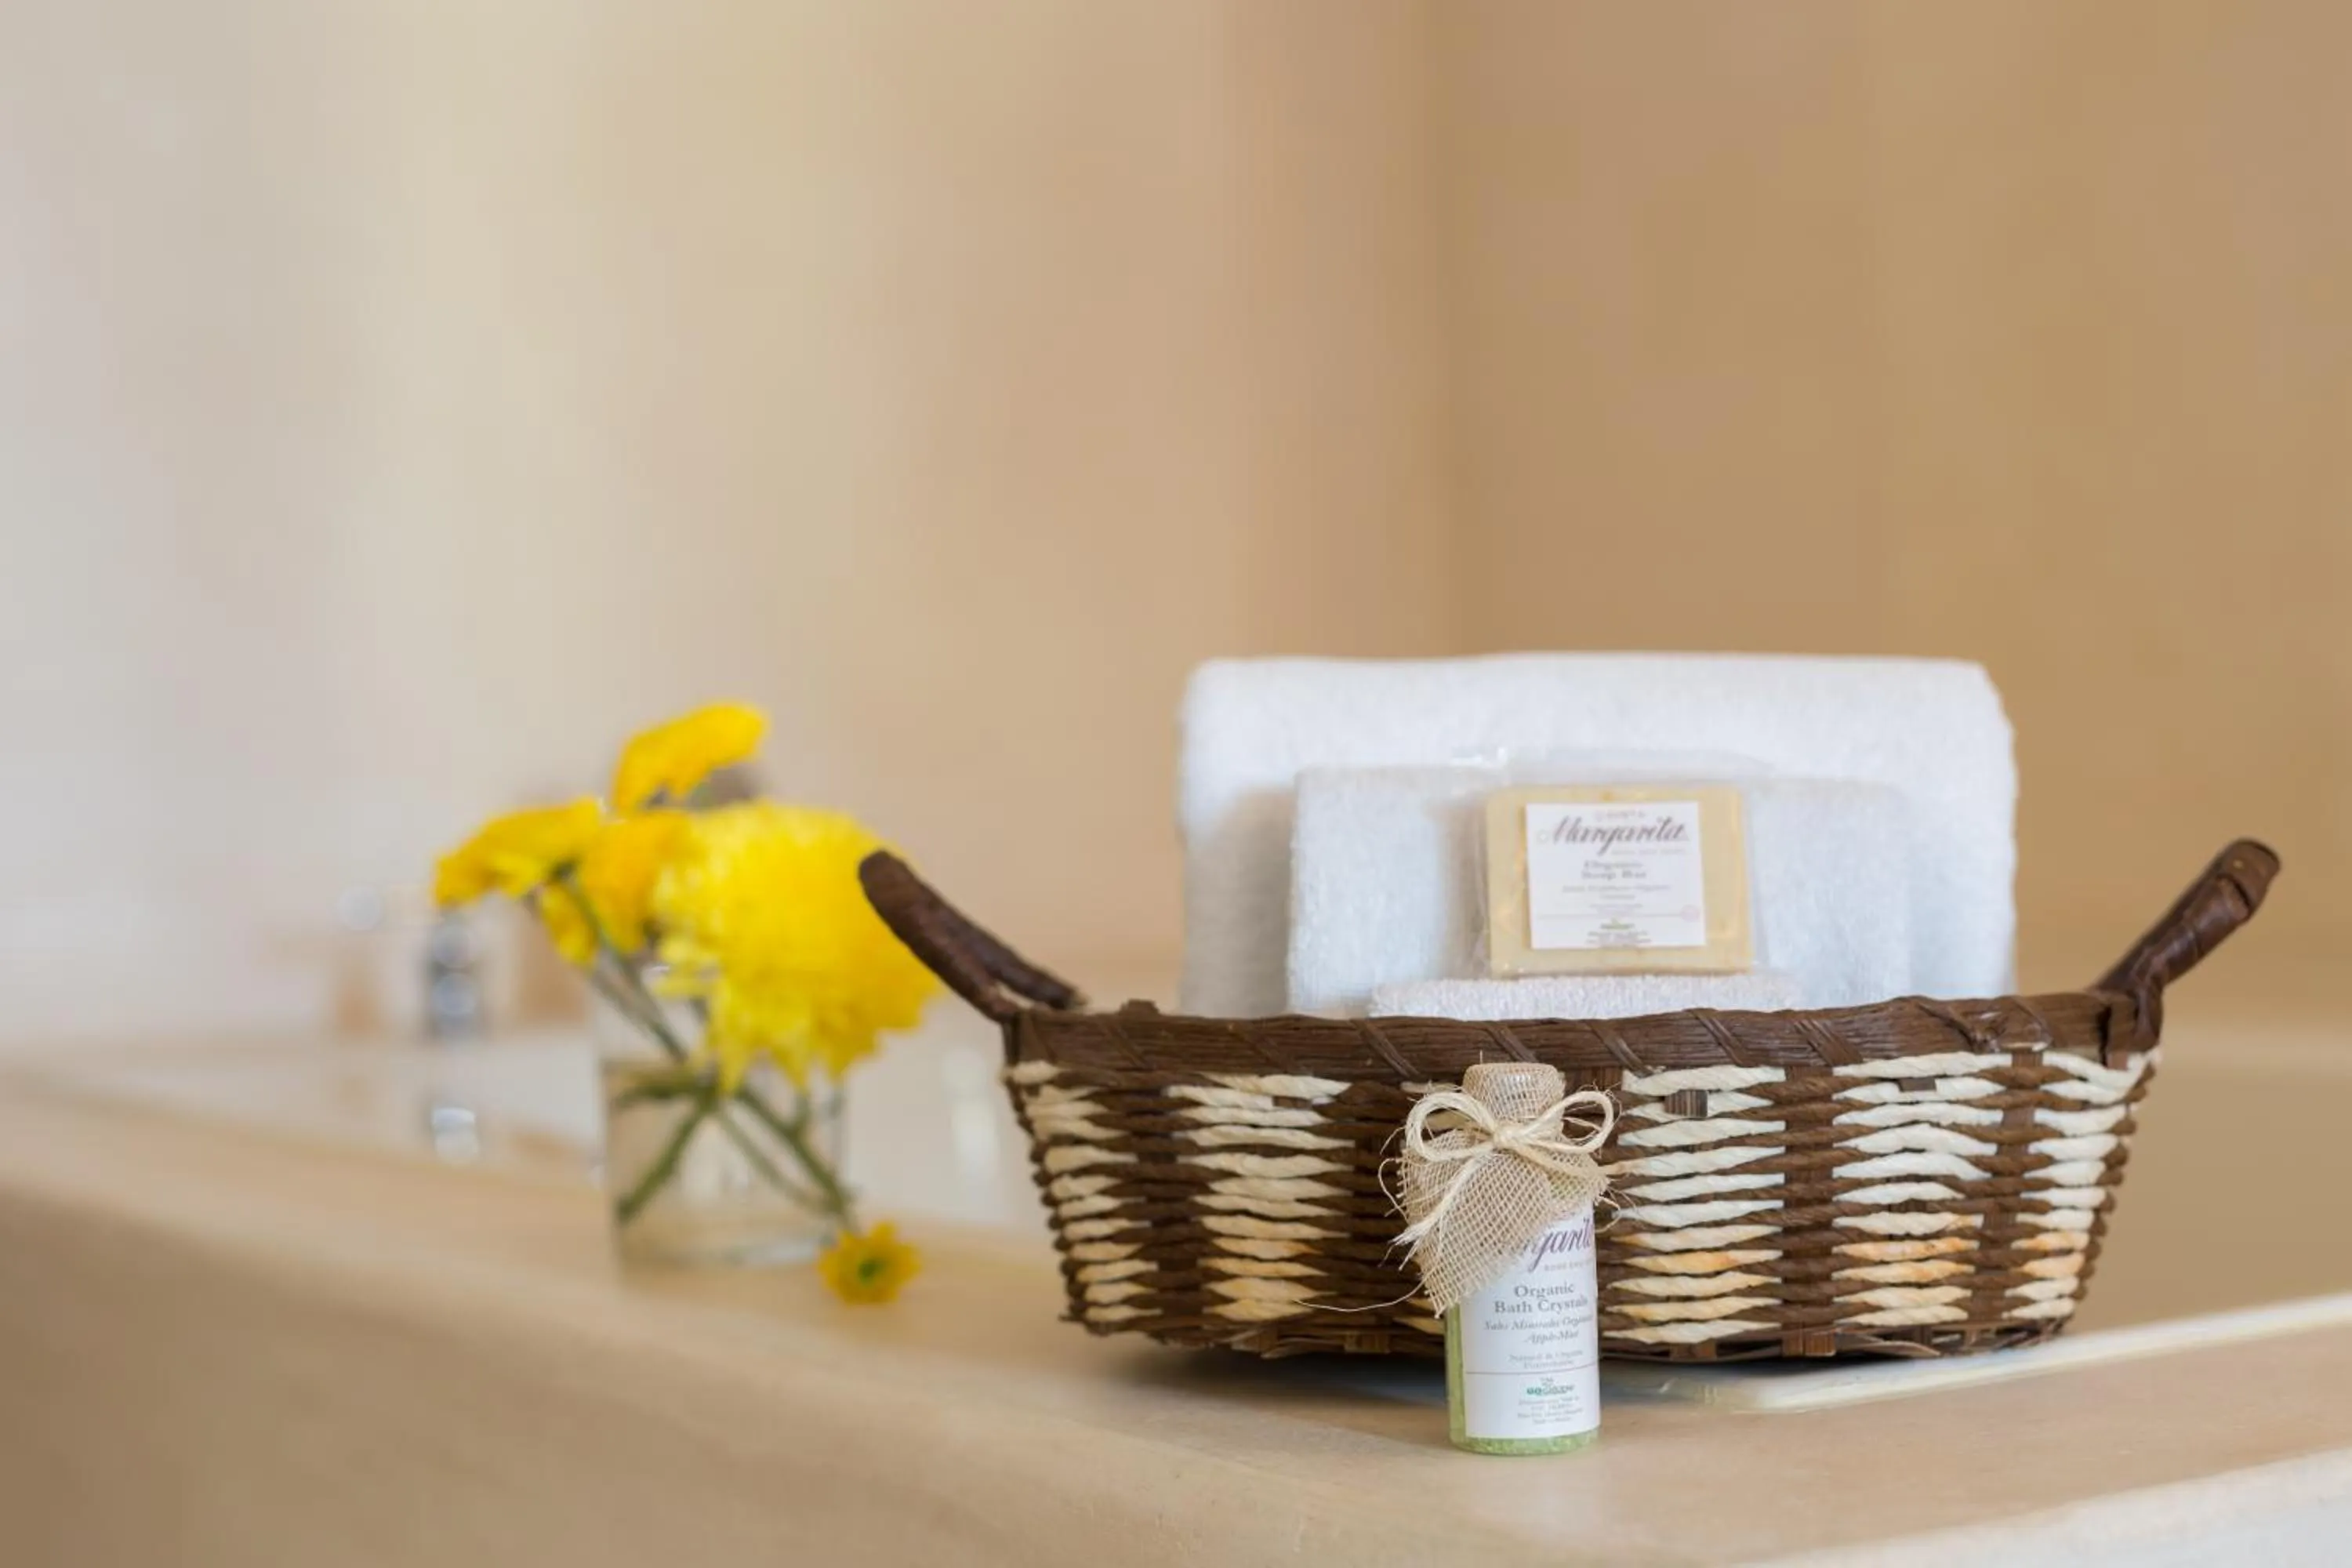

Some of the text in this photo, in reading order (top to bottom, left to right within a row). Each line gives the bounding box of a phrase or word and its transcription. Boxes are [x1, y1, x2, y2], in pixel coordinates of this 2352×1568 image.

[1553, 815, 1686, 856] Margarita
[1514, 1281, 1574, 1299] Organic
[1494, 1294, 1588, 1315] Bath Crystals
